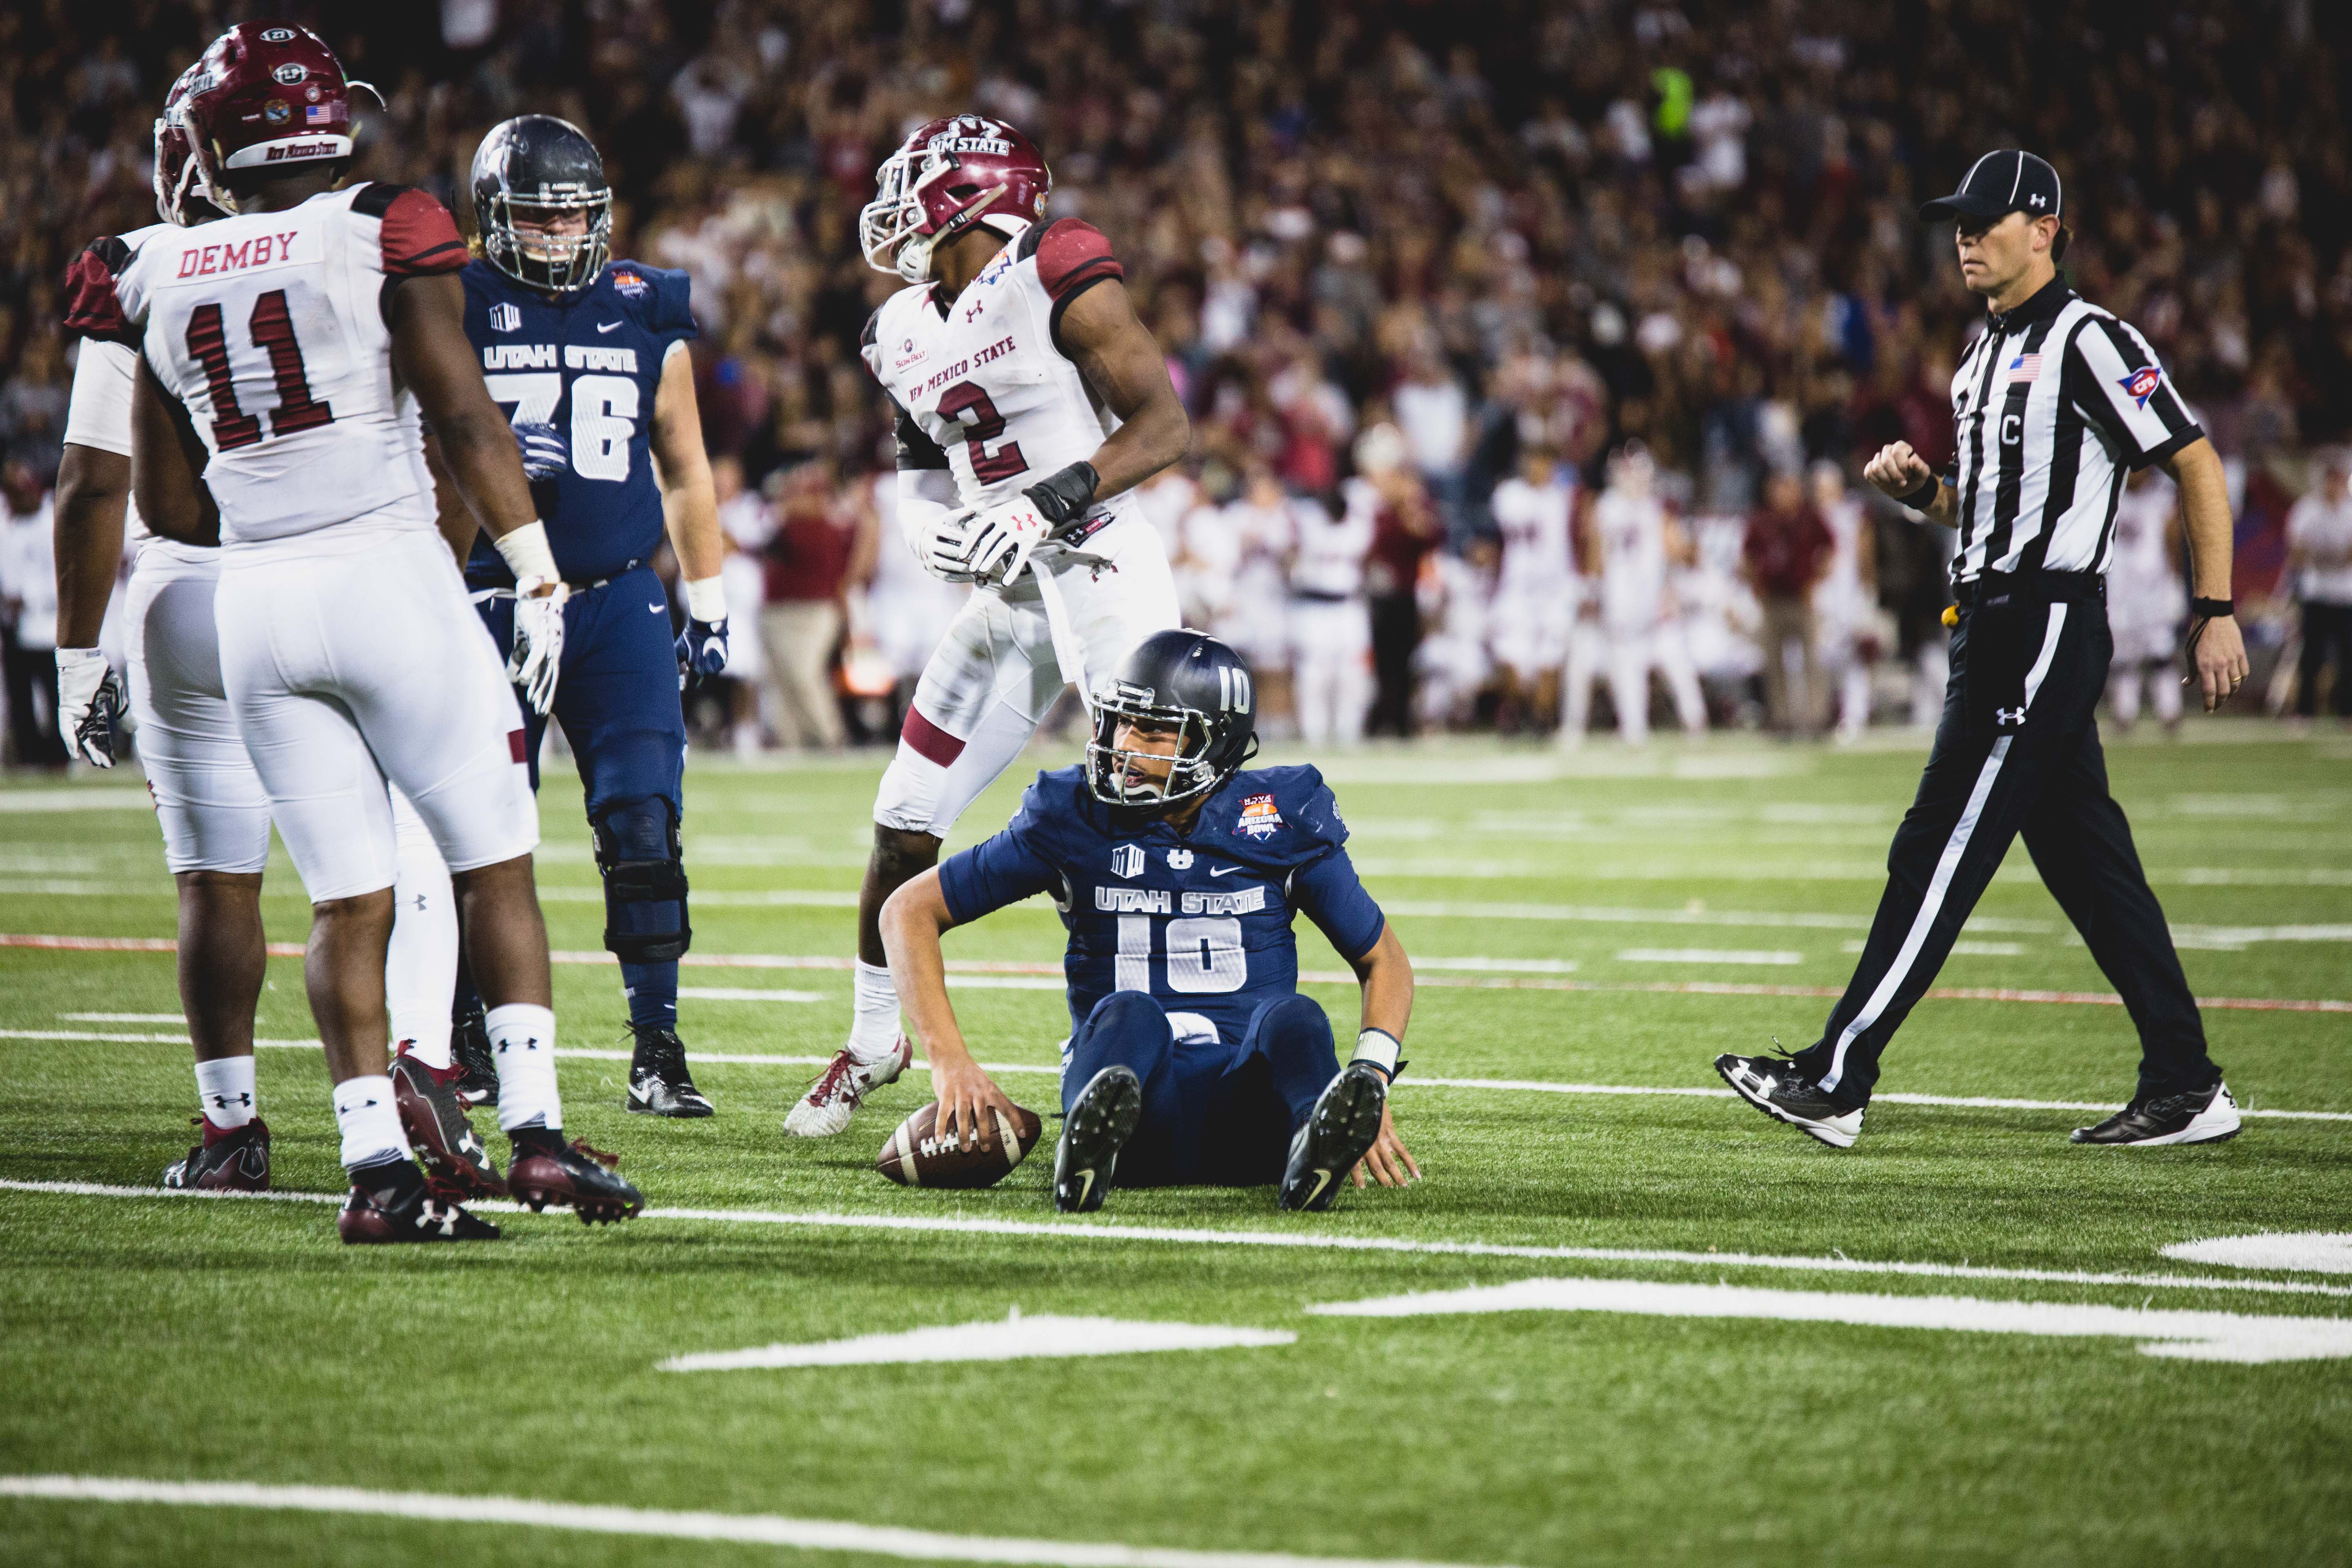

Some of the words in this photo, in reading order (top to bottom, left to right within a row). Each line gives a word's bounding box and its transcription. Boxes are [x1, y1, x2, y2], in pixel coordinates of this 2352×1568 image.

[957, 137, 1009, 154] STATE
[177, 231, 298, 278] DEMBY
[185, 289, 335, 452] 11
[483, 344, 557, 370] UTAH
[564, 345, 638, 373] STATE
[895, 357, 910, 368] SUN
[911, 350, 925, 363] BELT
[927, 359, 968, 392] MEXICO
[973, 335, 1016, 368] STATE
[483, 372, 639, 481] 76
[935, 380, 1030, 486] 2
[2001, 414, 2021, 445] C
[1218, 666, 1250, 715] 10
[1203, 773, 1224, 794] ADAMS
[1244, 794, 1272, 804] NOVA
[1238, 813, 1283, 828] ARIZONA
[1247, 823, 1276, 835] BOWL
[1095, 886, 1172, 914] UTAH
[1181, 885, 1265, 915] STATE
[1114, 913, 1247, 994] 10
